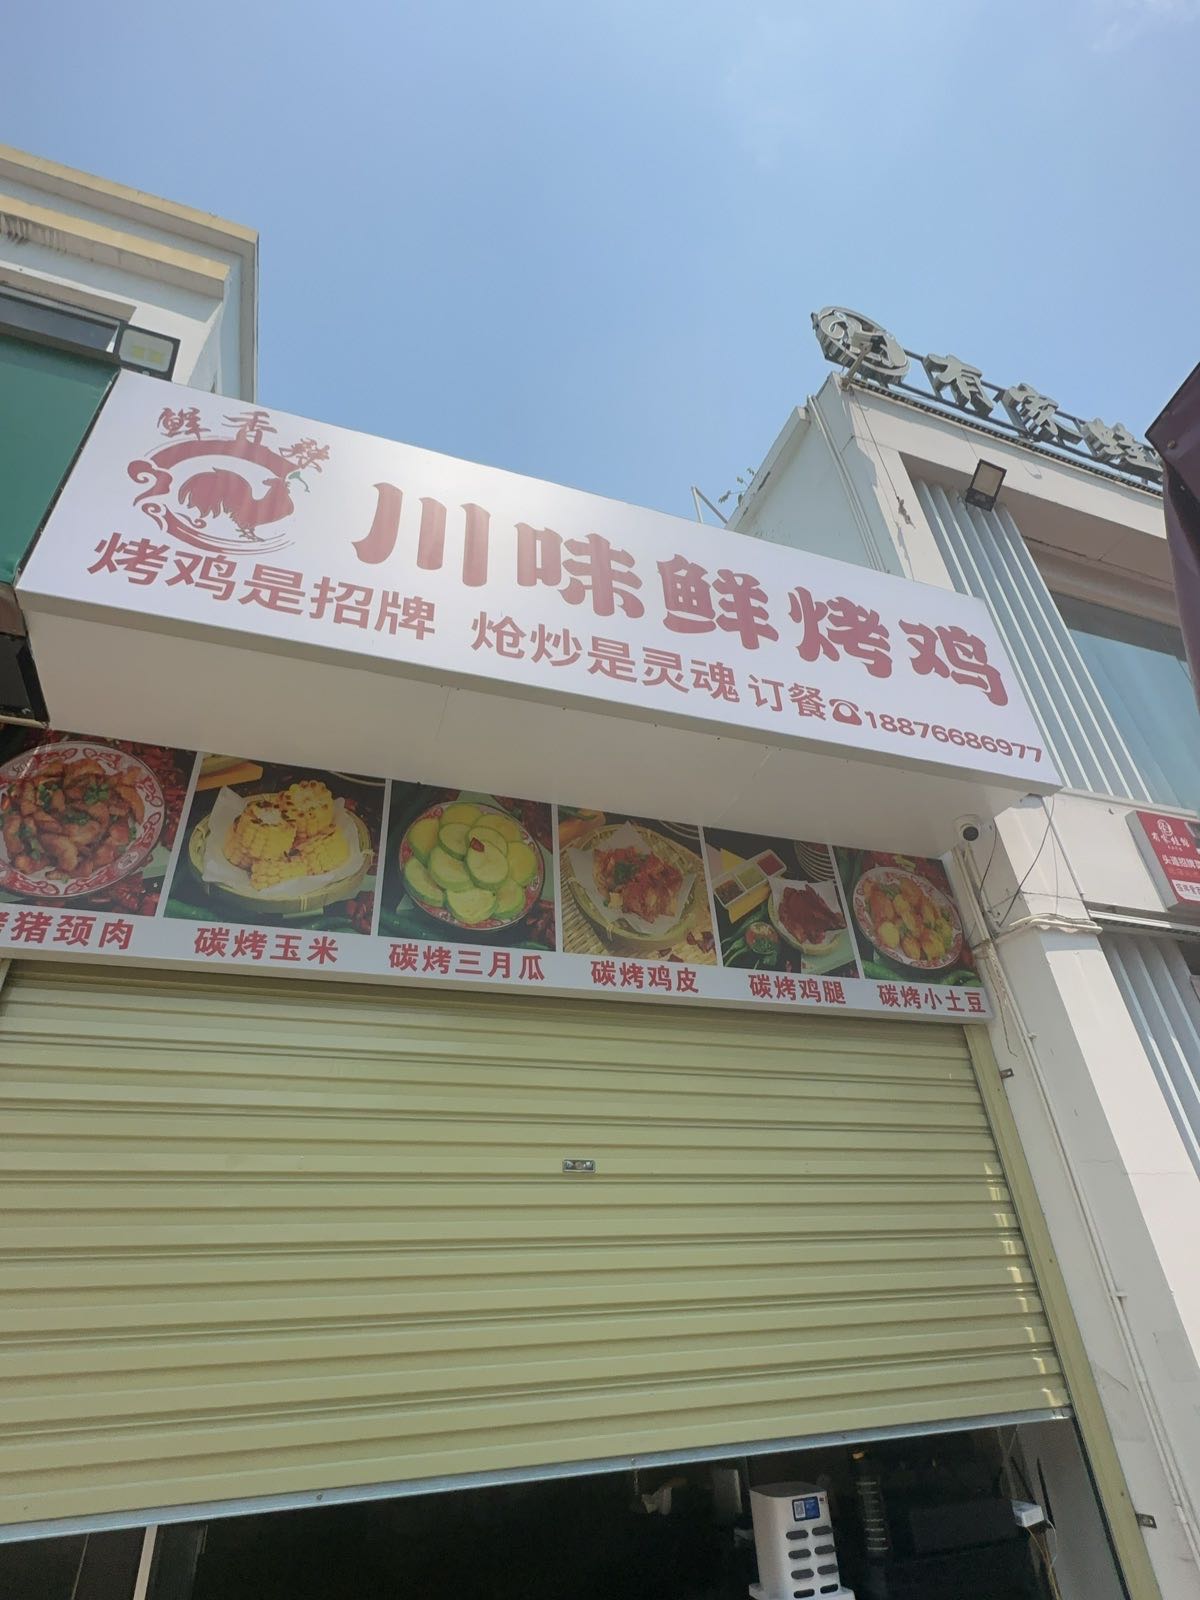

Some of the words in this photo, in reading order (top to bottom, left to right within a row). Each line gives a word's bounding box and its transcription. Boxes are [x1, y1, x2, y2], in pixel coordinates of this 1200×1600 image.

[351, 481, 1009, 707] 川味鲜烤鸡
[86, 531, 436, 641] 烤鸡是招牌
[470, 610, 740, 704] 炝炒是灵魂
[747, 673, 827, 721] 订餐
[863, 710, 1043, 763] 18876686977
[193, 926, 340, 964] 碳烤玉米
[388, 942, 546, 981] 碳烤三月瓜
[590, 960, 700, 993] 碳烤鸡皮
[748, 973, 847, 1005] 碳烤鸡腿
[876, 983, 987, 1014] 碳烤小土豆
